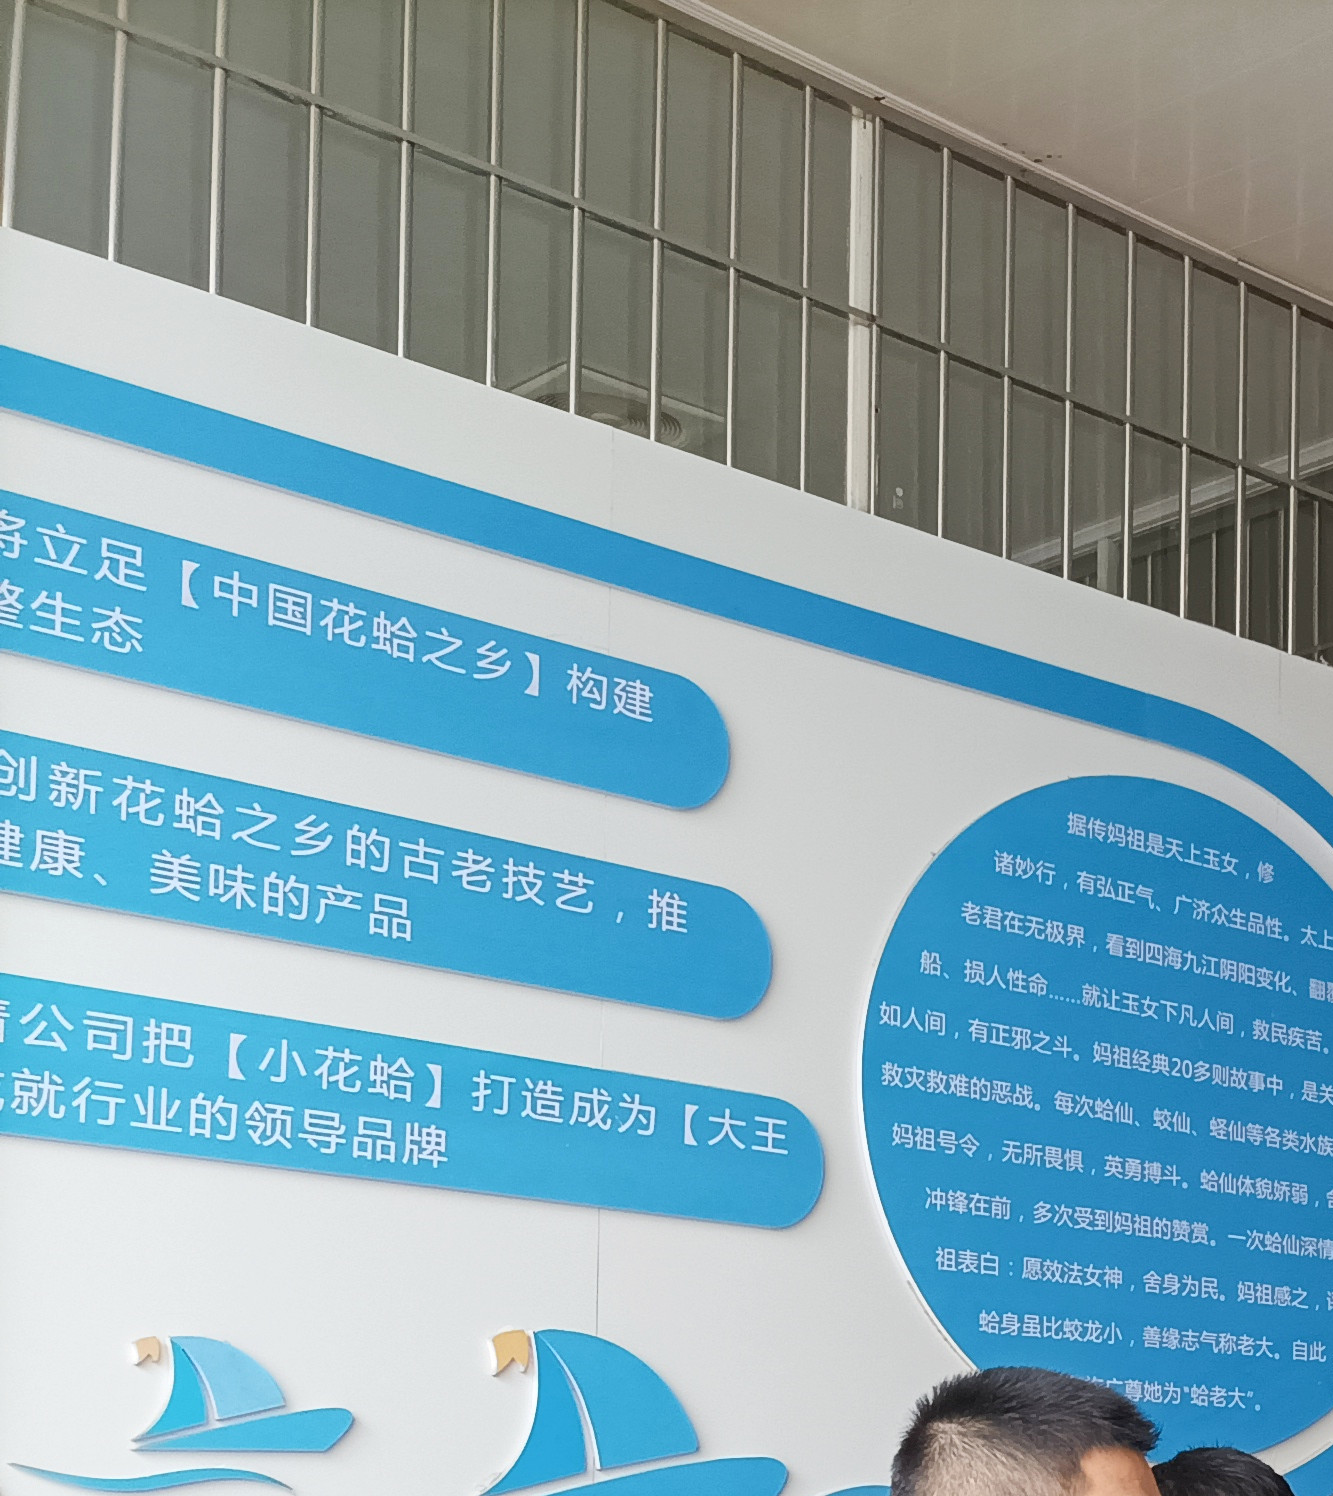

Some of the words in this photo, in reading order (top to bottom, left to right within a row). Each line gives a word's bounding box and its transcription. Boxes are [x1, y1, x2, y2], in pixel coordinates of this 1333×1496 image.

[1067, 812, 1275, 884] 据传妈祖是天上玉女，修
[0, 1000, 790, 1155] 公司把【小花蛤】打造成为【大王
[0, 1067, 448, 1168] 就行业的领导品牌
